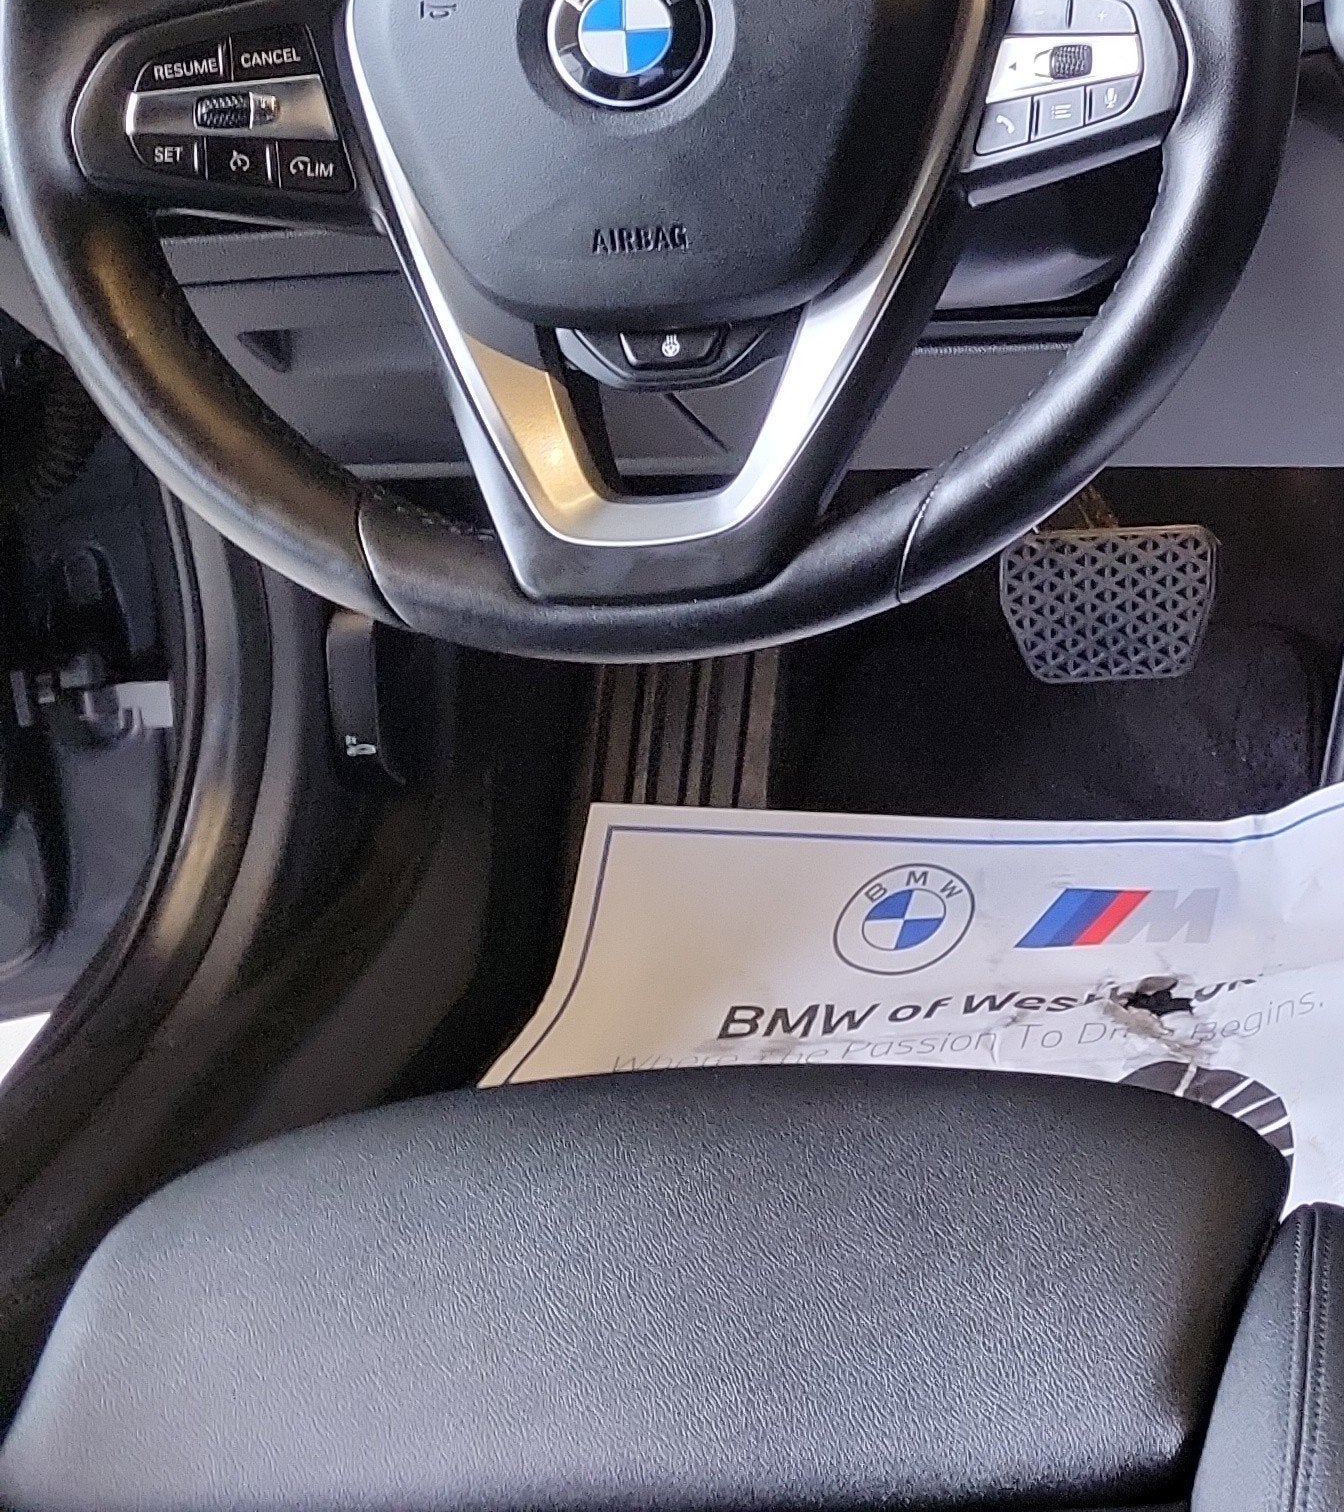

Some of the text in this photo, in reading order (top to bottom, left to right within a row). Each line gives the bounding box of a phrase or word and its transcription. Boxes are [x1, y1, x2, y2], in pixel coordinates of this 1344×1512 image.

[153, 57, 220, 81] RESUME
[240, 47, 302, 69] CANCEL
[154, 146, 183, 163] SET
[306, 162, 335, 178] LIM
[592, 223, 690, 256] AIRBAG
[864, 870, 963, 904] BMW
[717, 1001, 882, 1040] BMW
[887, 996, 954, 1024] of
[842, 1030, 996, 1060] Passion
[1019, 1023, 1063, 1050] To
[1191, 990, 1325, 1042] Begins.
